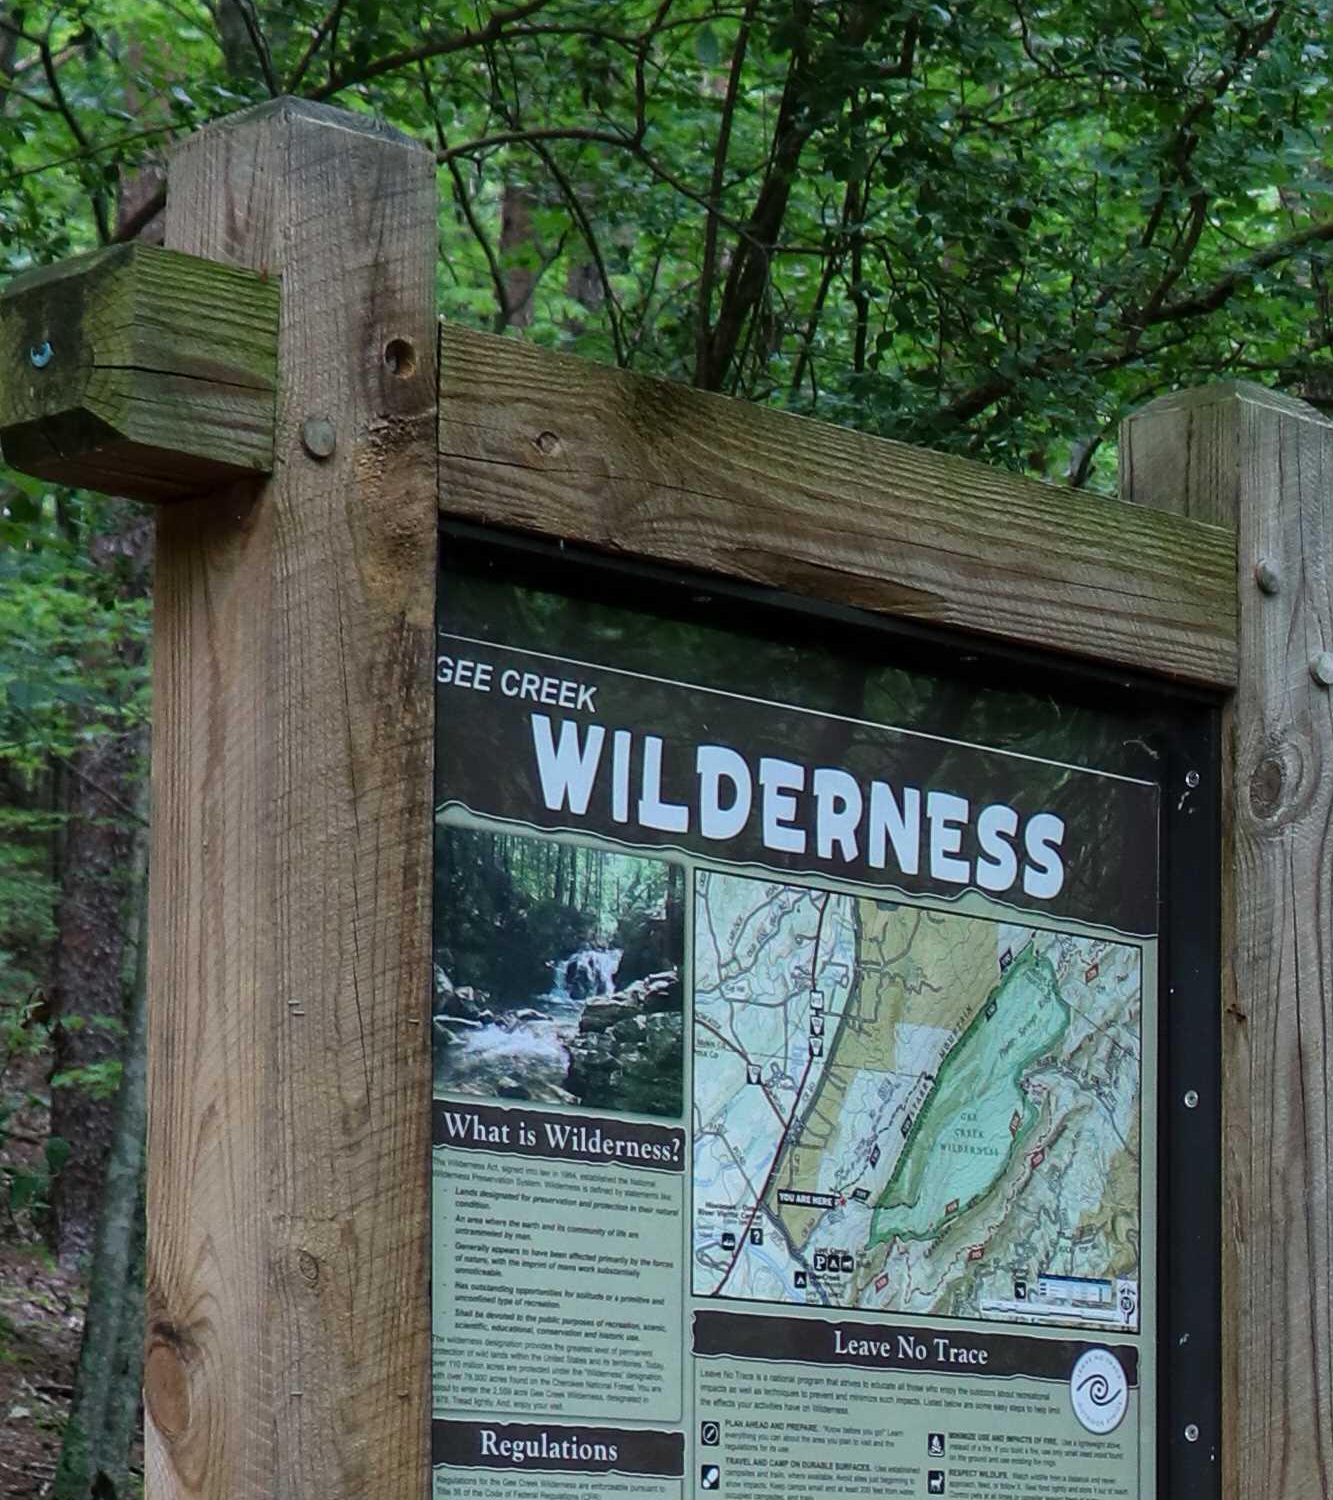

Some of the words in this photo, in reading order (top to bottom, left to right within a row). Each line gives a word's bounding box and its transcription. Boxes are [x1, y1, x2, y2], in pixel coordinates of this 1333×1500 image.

[436, 656, 494, 692] GEE
[501, 669, 598, 713] CREEK
[531, 713, 1065, 900] WILDERNESS
[443, 1112, 510, 1144] What
[519, 1122, 536, 1146] is
[544, 1123, 681, 1162] Wilderness?
[779, 1194, 795, 1203] YOU
[796, 1195, 809, 1204] ARE
[810, 1196, 833, 1206] HERE
[834, 1330, 890, 1357] Leave
[897, 1335, 927, 1360] No
[933, 1338, 988, 1364] Trace
[480, 1430, 618, 1462] Regulations
